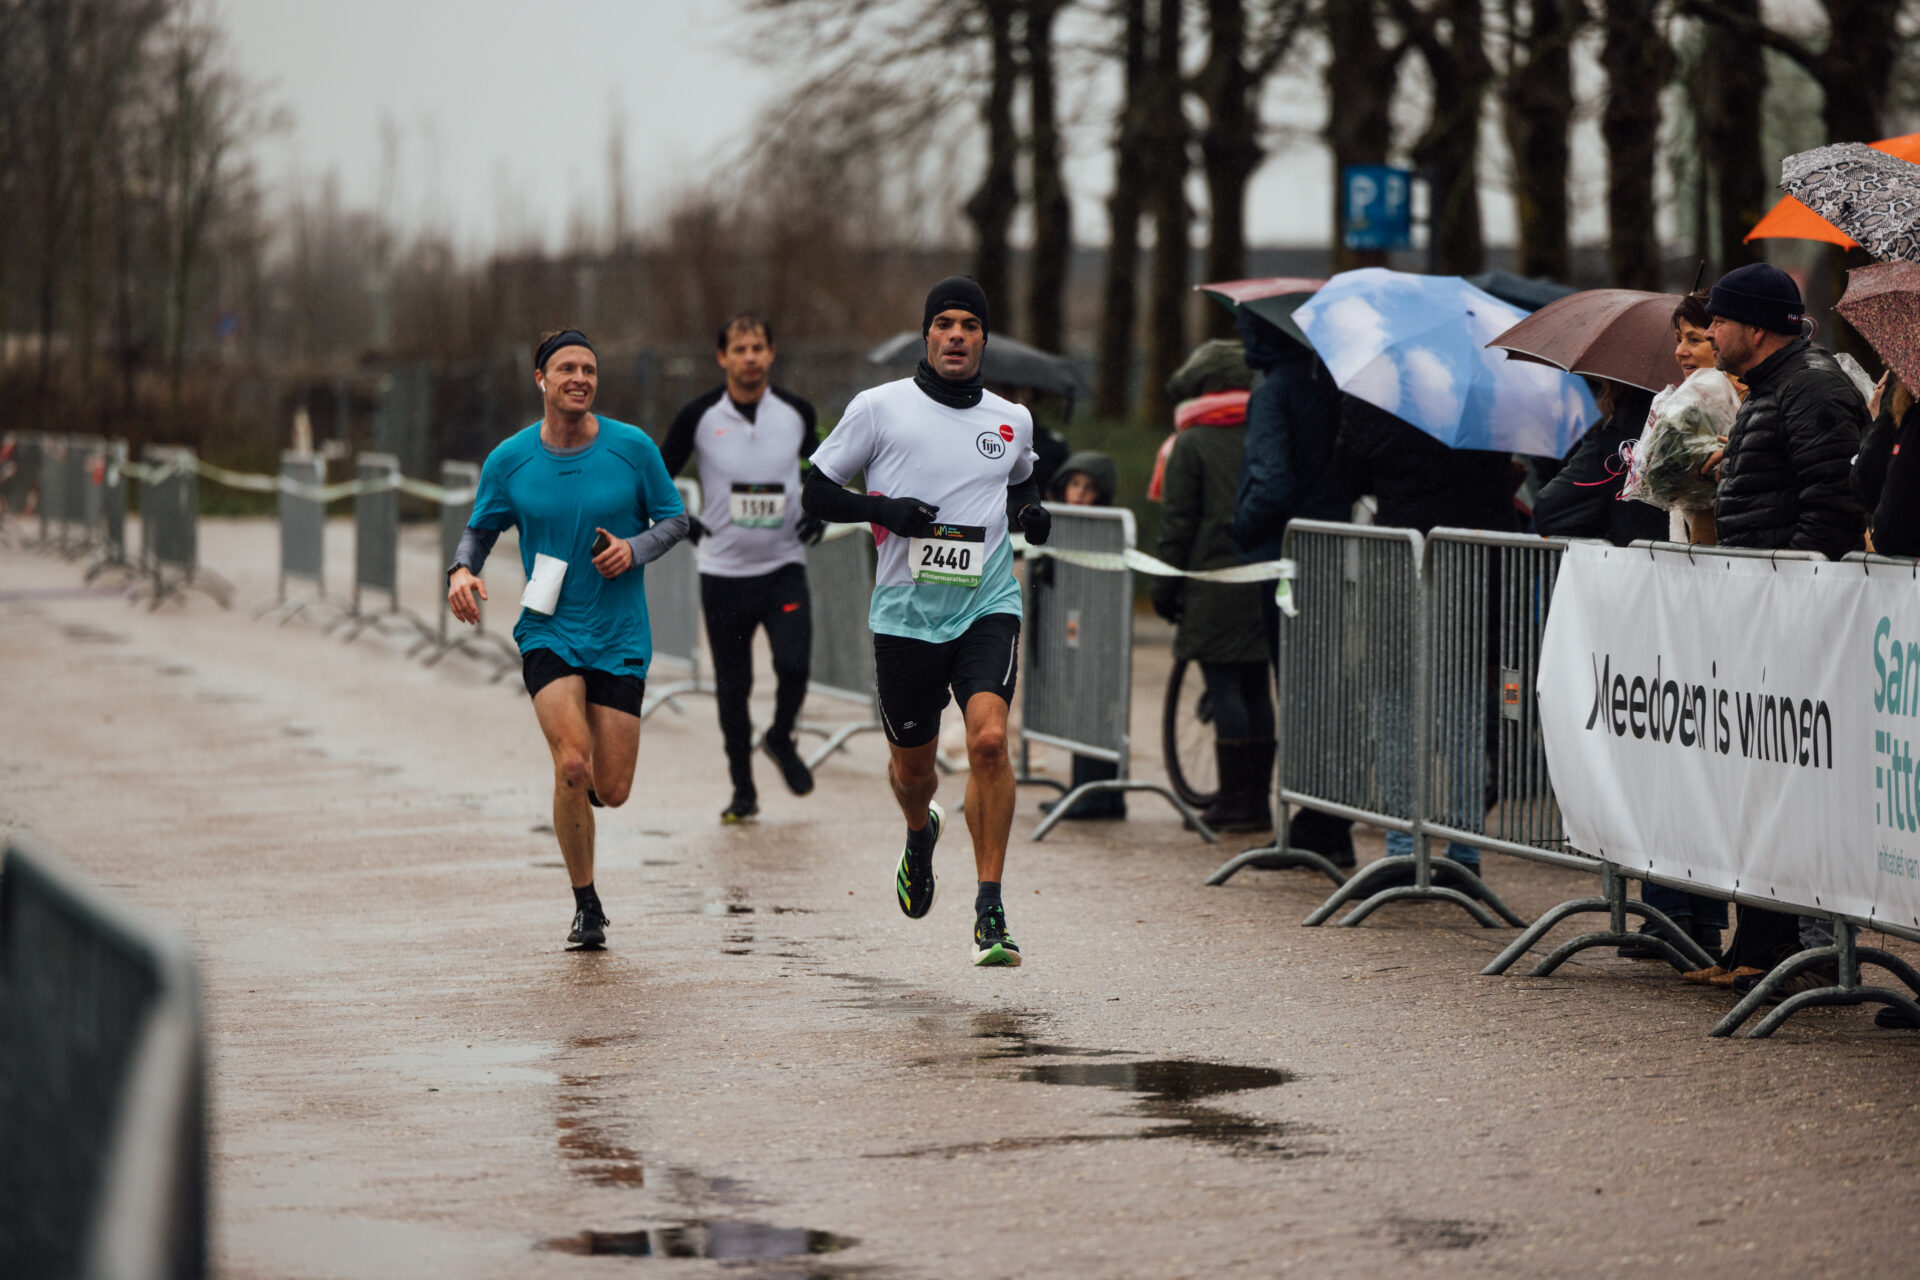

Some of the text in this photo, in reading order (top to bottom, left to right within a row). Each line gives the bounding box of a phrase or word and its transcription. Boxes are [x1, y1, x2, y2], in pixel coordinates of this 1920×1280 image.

[1350, 174, 1378, 220] P
[982, 438, 1001, 454] fijn
[921, 544, 971, 571] 2440
[1585, 652, 1833, 770] Meedoen is winnen
